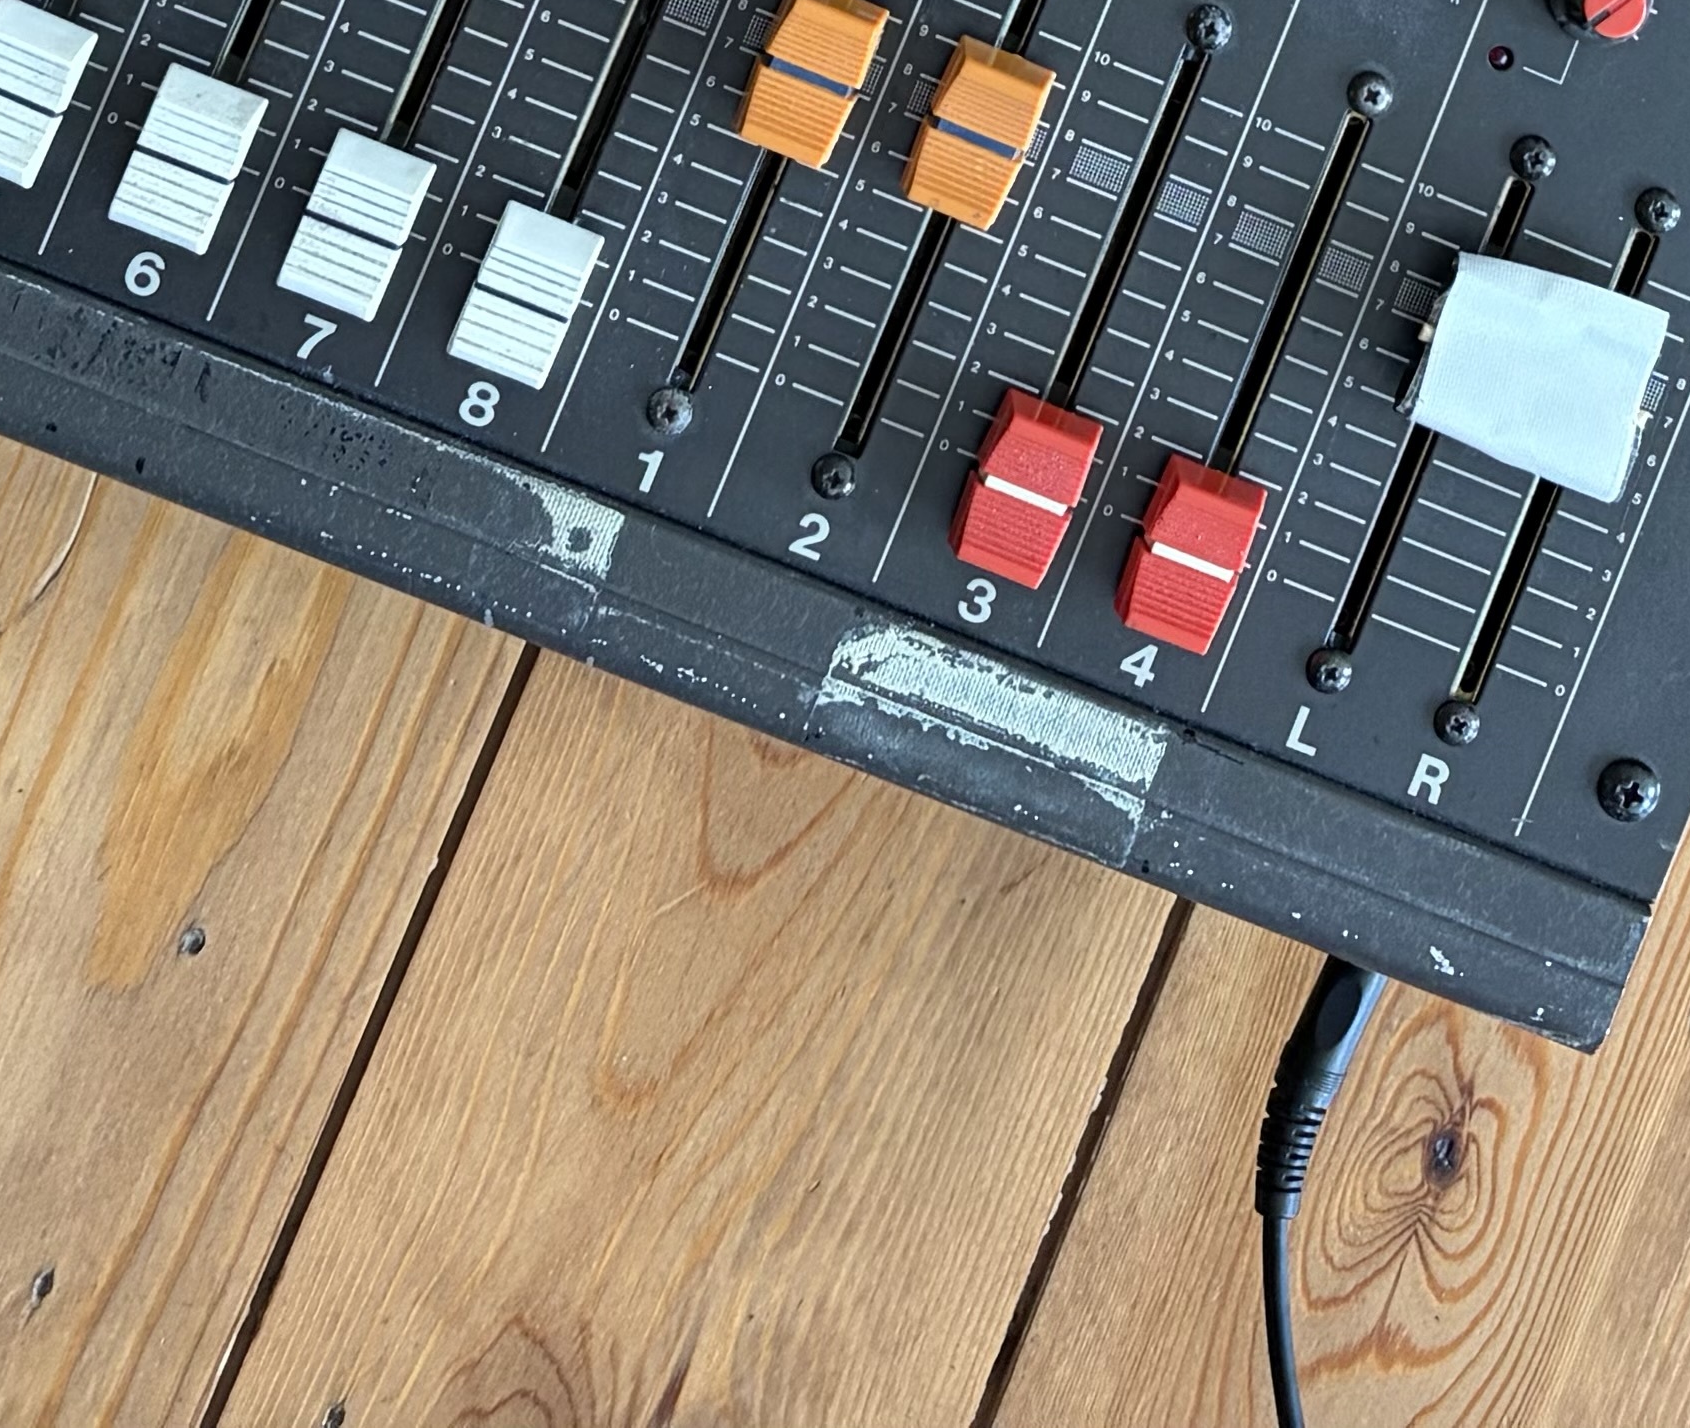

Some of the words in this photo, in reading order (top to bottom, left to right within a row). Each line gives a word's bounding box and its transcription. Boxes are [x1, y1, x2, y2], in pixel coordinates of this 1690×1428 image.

[124, 251, 166, 297] 6
[296, 313, 338, 360] 7
[458, 380, 501, 428] 8
[637, 449, 665, 494] 1
[788, 512, 831, 562] 2
[957, 577, 997, 624] 3
[1119, 644, 1159, 688] 4
[1285, 705, 1317, 757] L
[1406, 752, 1450, 806] R
